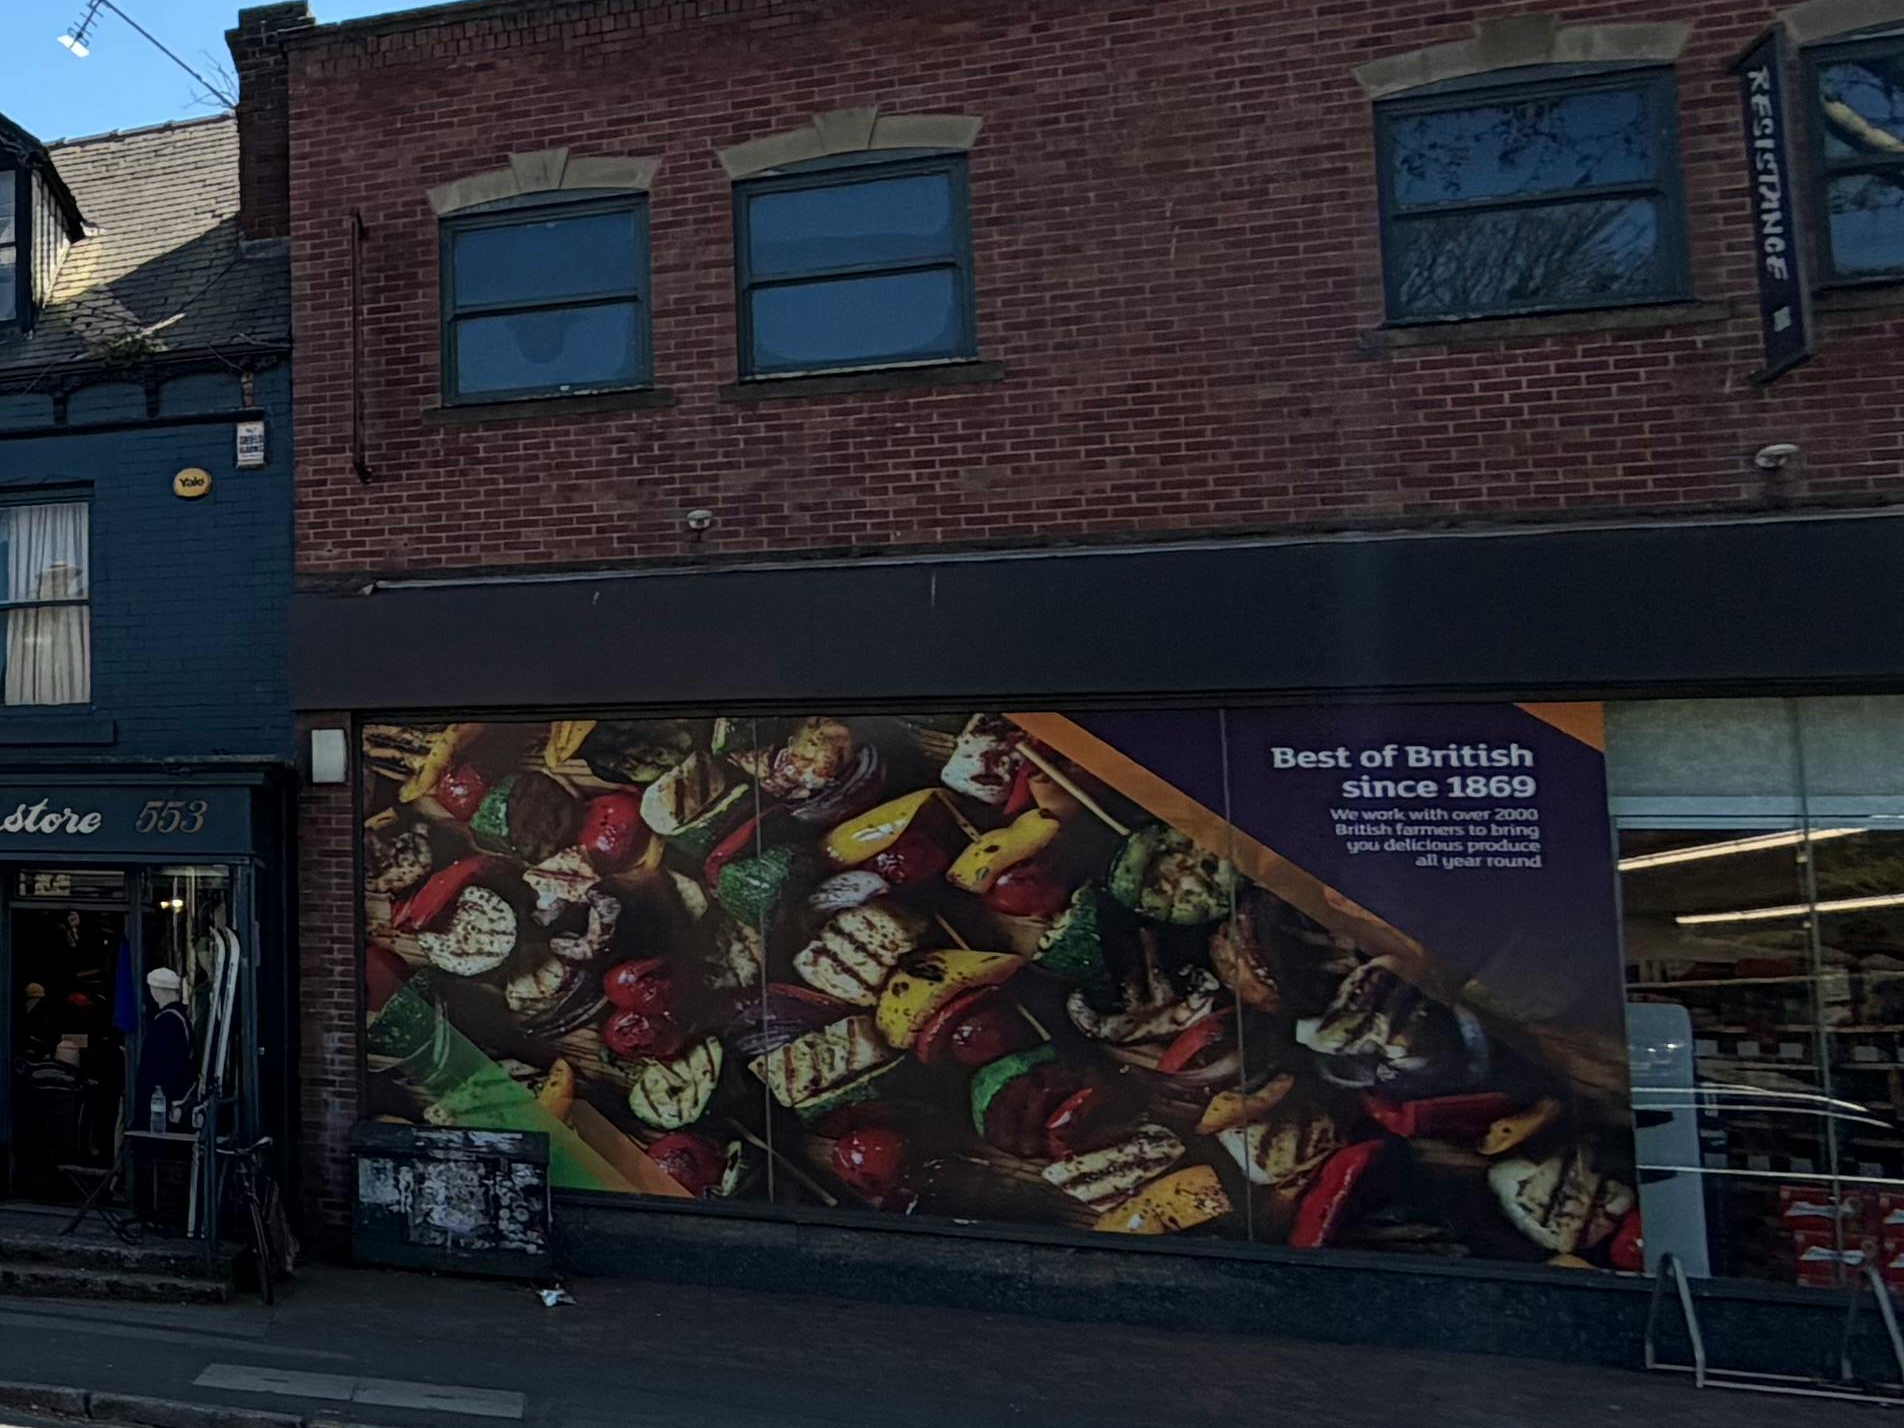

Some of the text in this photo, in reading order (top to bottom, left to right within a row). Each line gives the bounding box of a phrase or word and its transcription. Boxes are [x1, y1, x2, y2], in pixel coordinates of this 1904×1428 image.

[1747, 64, 1790, 283] RESISTANCE
[1270, 743, 1535, 769] Best of British
[1342, 774, 1537, 799] since 1869
[135, 799, 209, 834] 553
[1330, 808, 1538, 822] We work with over 2000
[1335, 823, 1540, 840] British farmers to bring
[1347, 839, 1542, 854] you delicious produce
[1415, 854, 1543, 870] all year round
